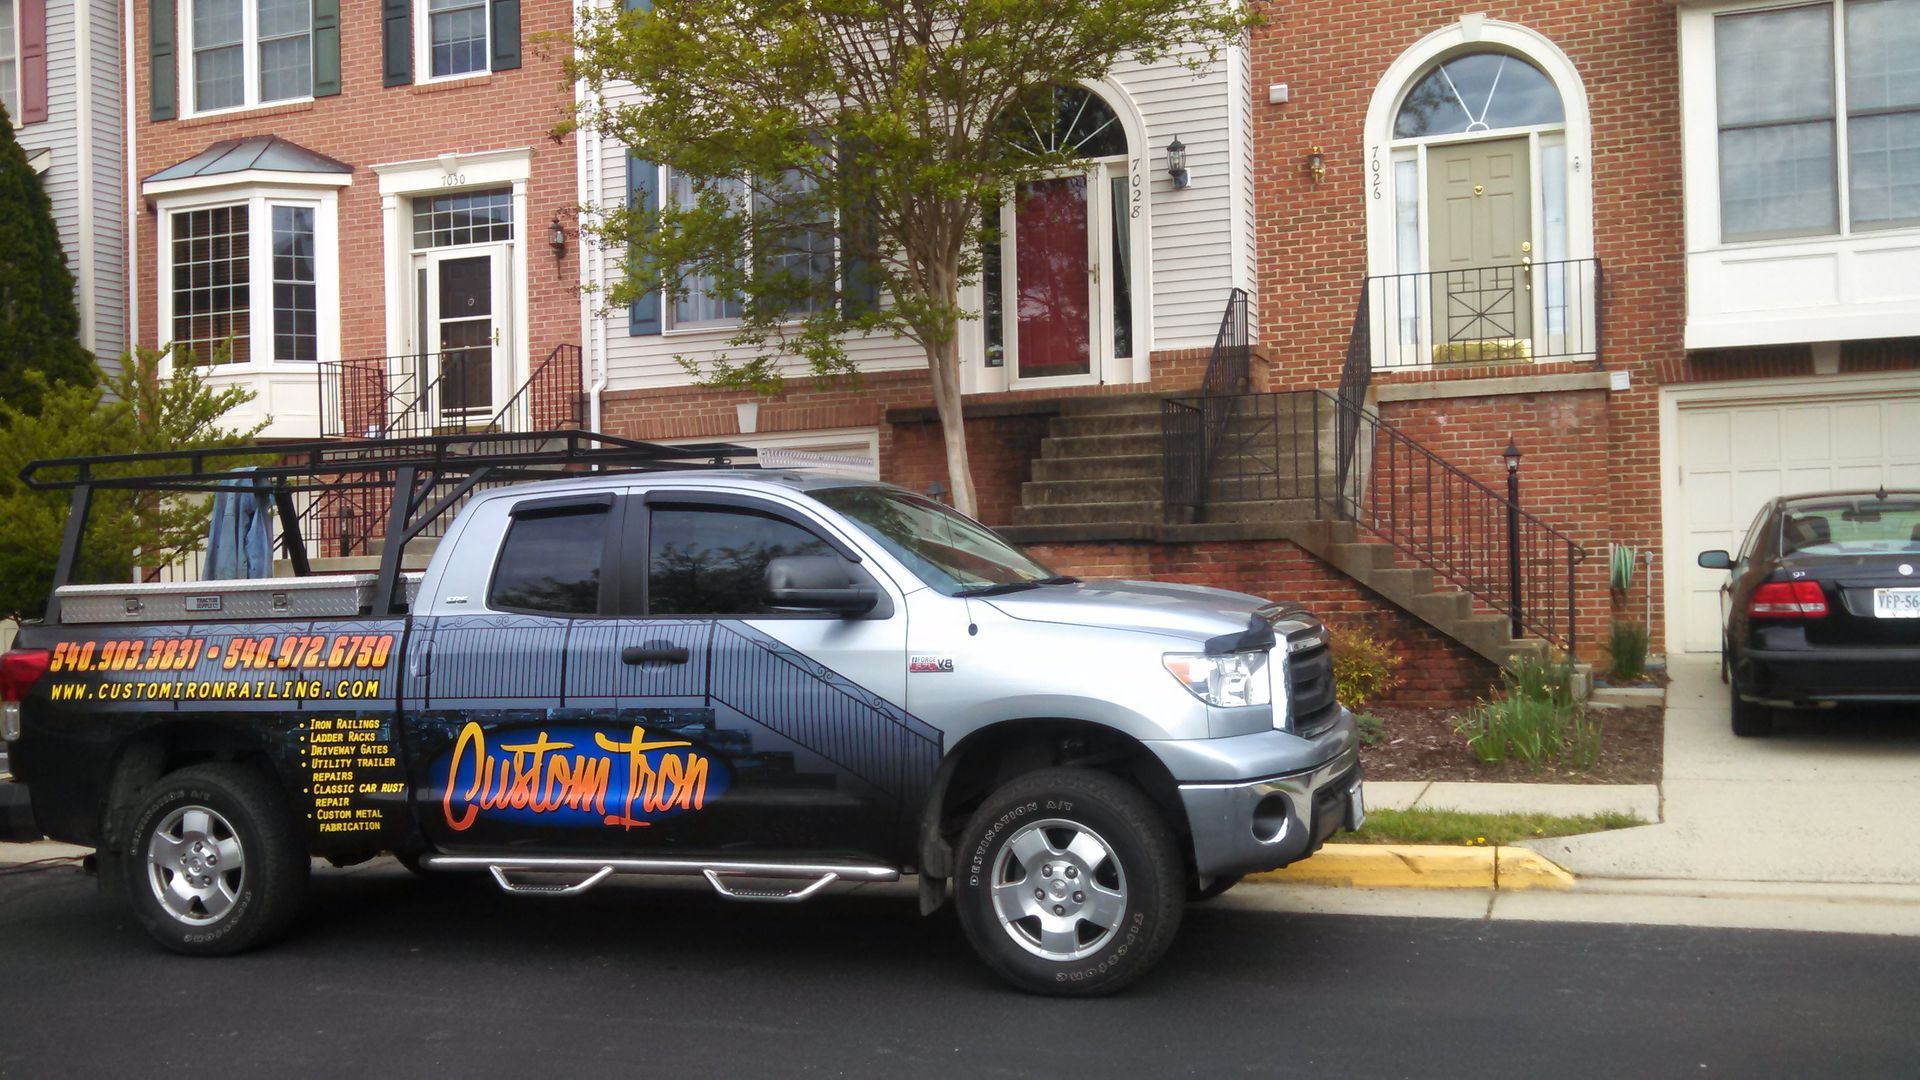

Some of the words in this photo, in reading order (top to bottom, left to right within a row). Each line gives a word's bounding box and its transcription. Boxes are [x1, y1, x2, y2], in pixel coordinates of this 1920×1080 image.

[1372, 145, 1382, 200] 7026
[441, 173, 466, 186] 7030
[1130, 157, 1142, 219] 7028
[1879, 594, 1920, 609] VFP-56
[50, 639, 204, 672] 540.903.3831
[223, 635, 394, 670] 540.972.6750
[937, 658, 953, 669] V8
[51, 680, 380, 700] WWW.CUSTOMIRONRAILING.COM
[309, 719, 332, 730] IRON
[336, 718, 380, 729] RAILINGS
[310, 731, 344, 743] LADDER
[348, 731, 376, 742] RACKS
[310, 744, 356, 756] DRIVEWAY
[360, 743, 388, 754] GATES
[311, 758, 352, 769] UTILITY
[357, 758, 396, 767] TRAILER
[312, 771, 354, 782] REPAIRS
[443, 721, 611, 831] Custom
[313, 783, 355, 795] CLASSIC
[359, 783, 377, 793] CAR
[380, 783, 405, 793] RUST
[315, 797, 350, 807] REPAIR
[316, 809, 352, 820] CUSTOM
[355, 809, 383, 819] METAL
[319, 821, 381, 832] FABRICATION
[969, 801, 1038, 887] DESTINATION
[1045, 800, 1073, 811] A/T
